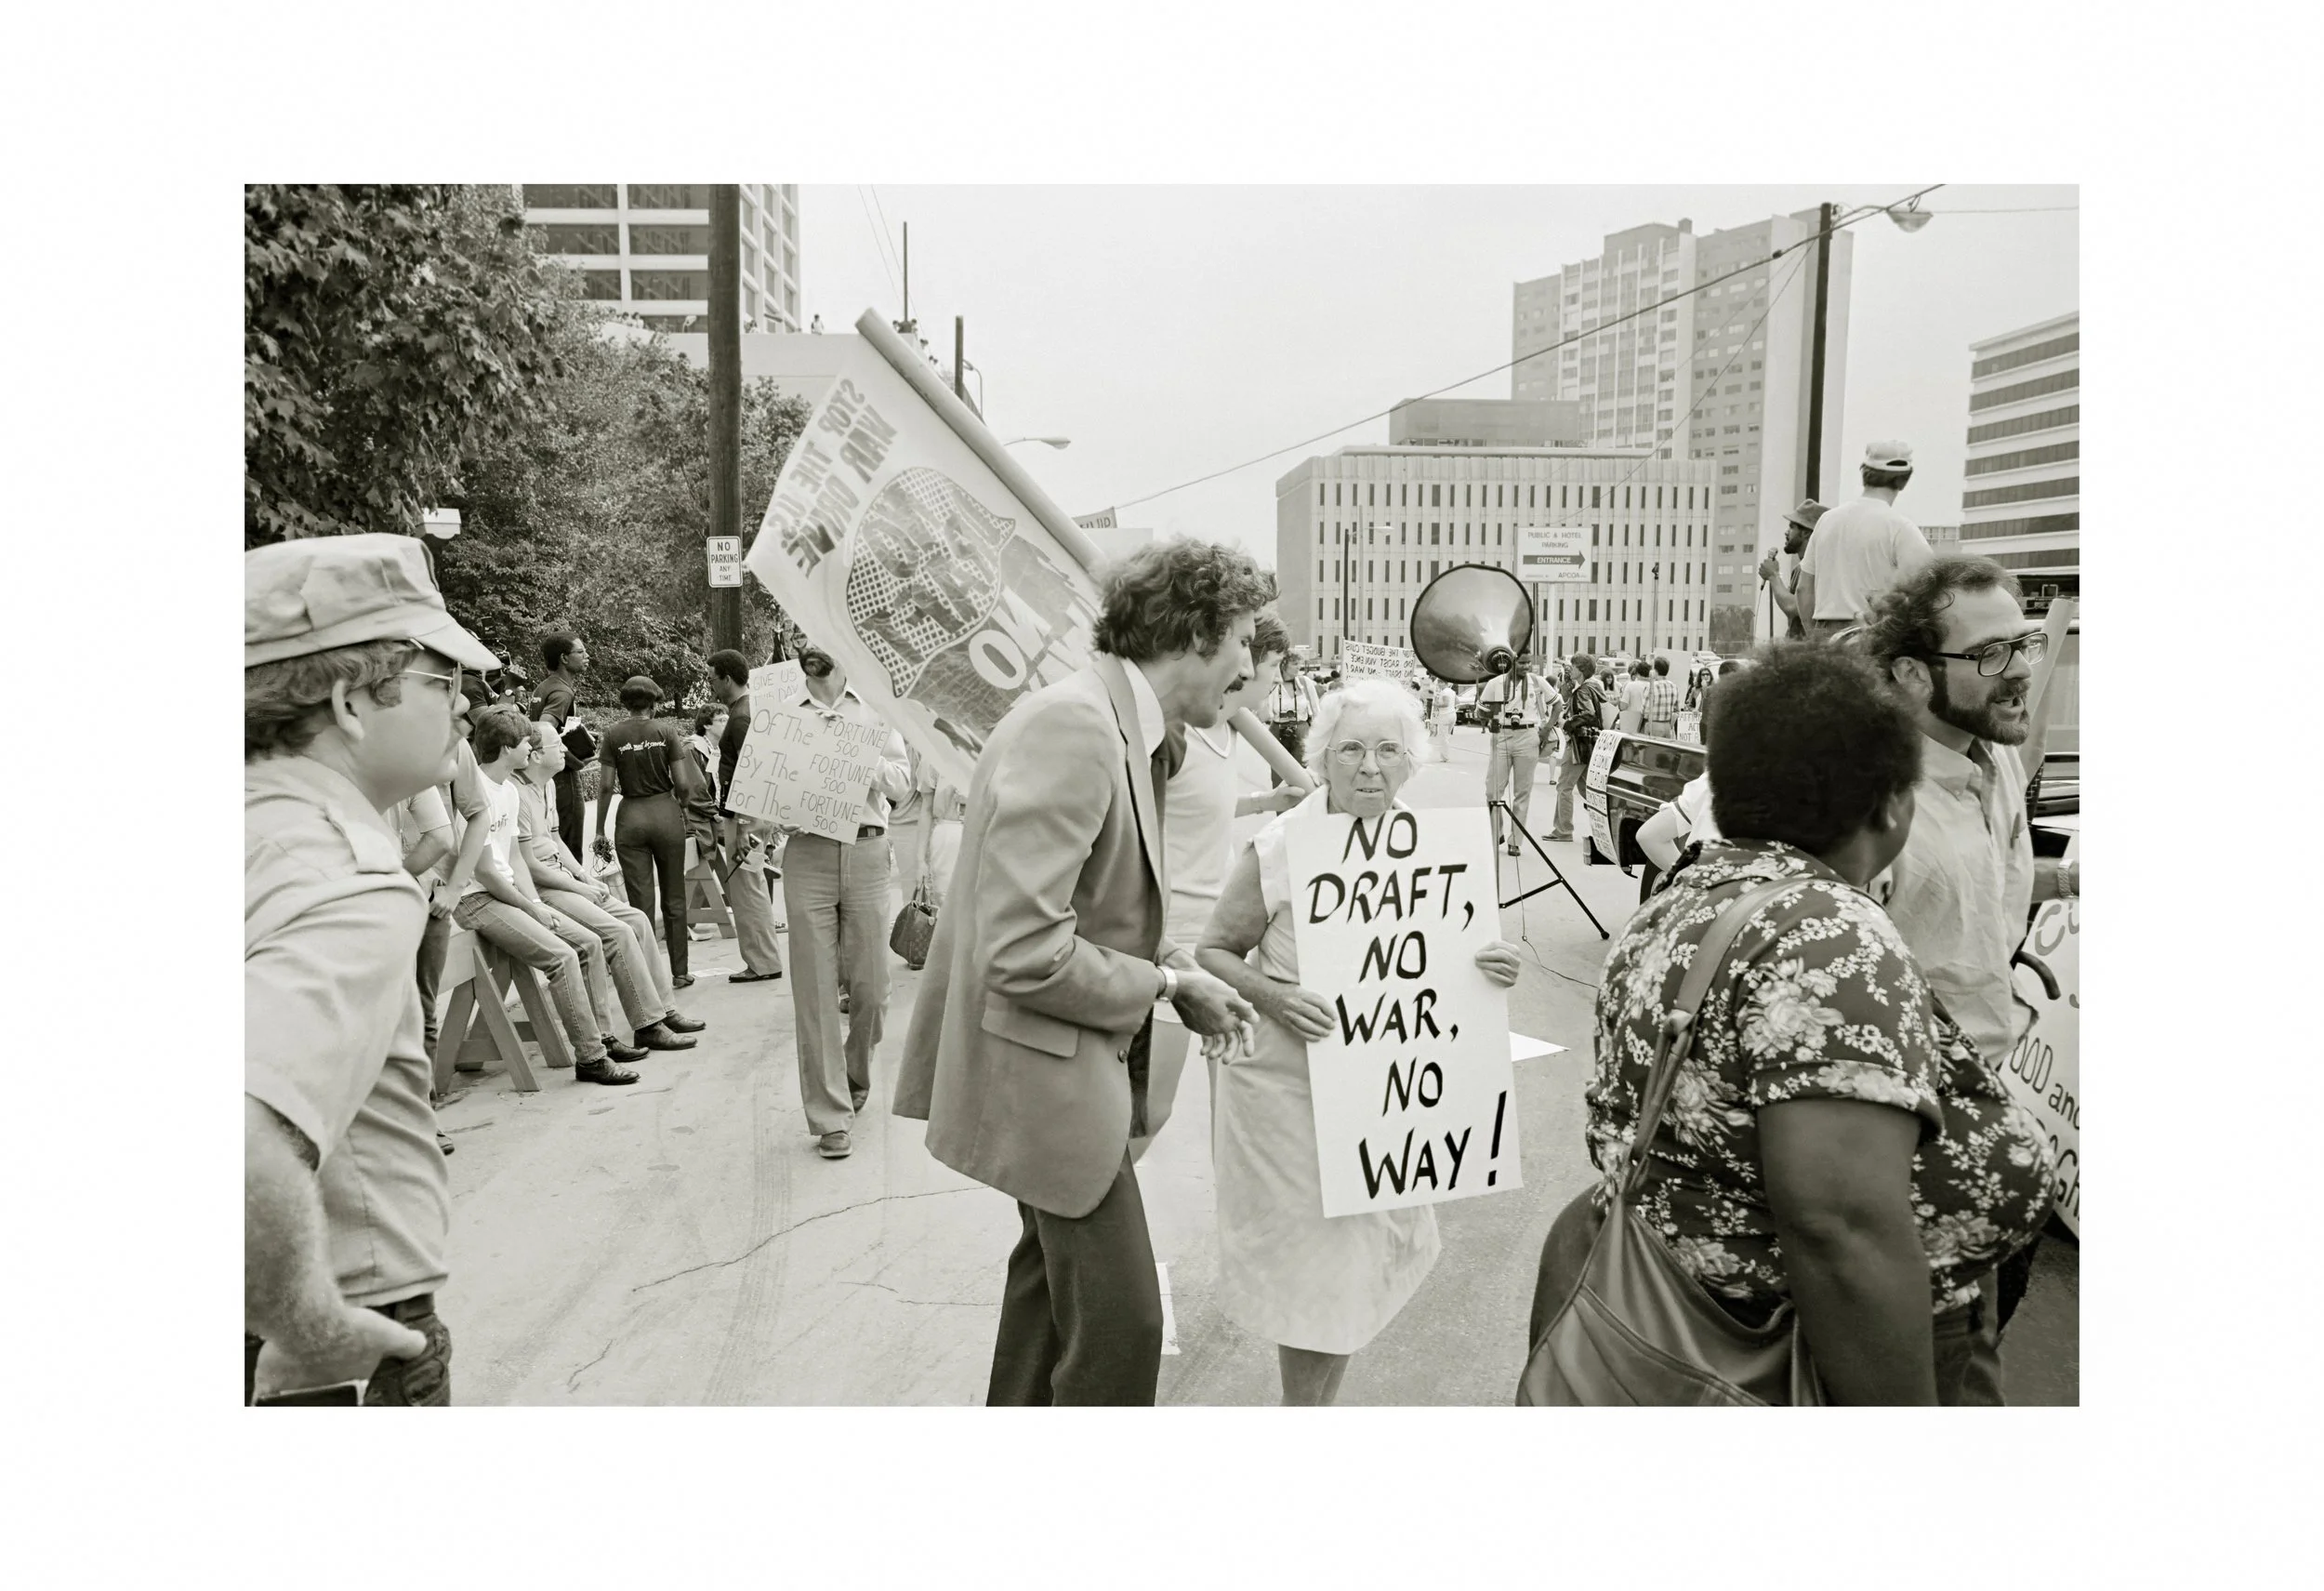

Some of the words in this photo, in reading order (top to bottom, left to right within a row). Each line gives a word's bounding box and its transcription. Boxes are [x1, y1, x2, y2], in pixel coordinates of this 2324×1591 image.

[710, 553, 738, 563] PARKING
[717, 541, 731, 551] NO
[754, 672, 773, 691] GIVE
[781, 669, 798, 683] US
[783, 714, 814, 747] The
[823, 719, 889, 754] FORTUNE
[835, 739, 860, 759] 500
[739, 744, 763, 779] By
[772, 750, 799, 782] The
[809, 753, 876, 787] FORTUNE
[821, 776, 847, 795] 500
[728, 780, 757, 809] For
[761, 780, 792, 821] The
[799, 790, 863, 825] FORTUNE
[812, 815, 838, 834] 500
[1341, 812, 1418, 863] NO
[1306, 864, 1474, 932] DRAFT,
[1358, 931, 1427, 984] NO
[1335, 988, 1459, 1047] WAR,
[1382, 1056, 1444, 1117] NO
